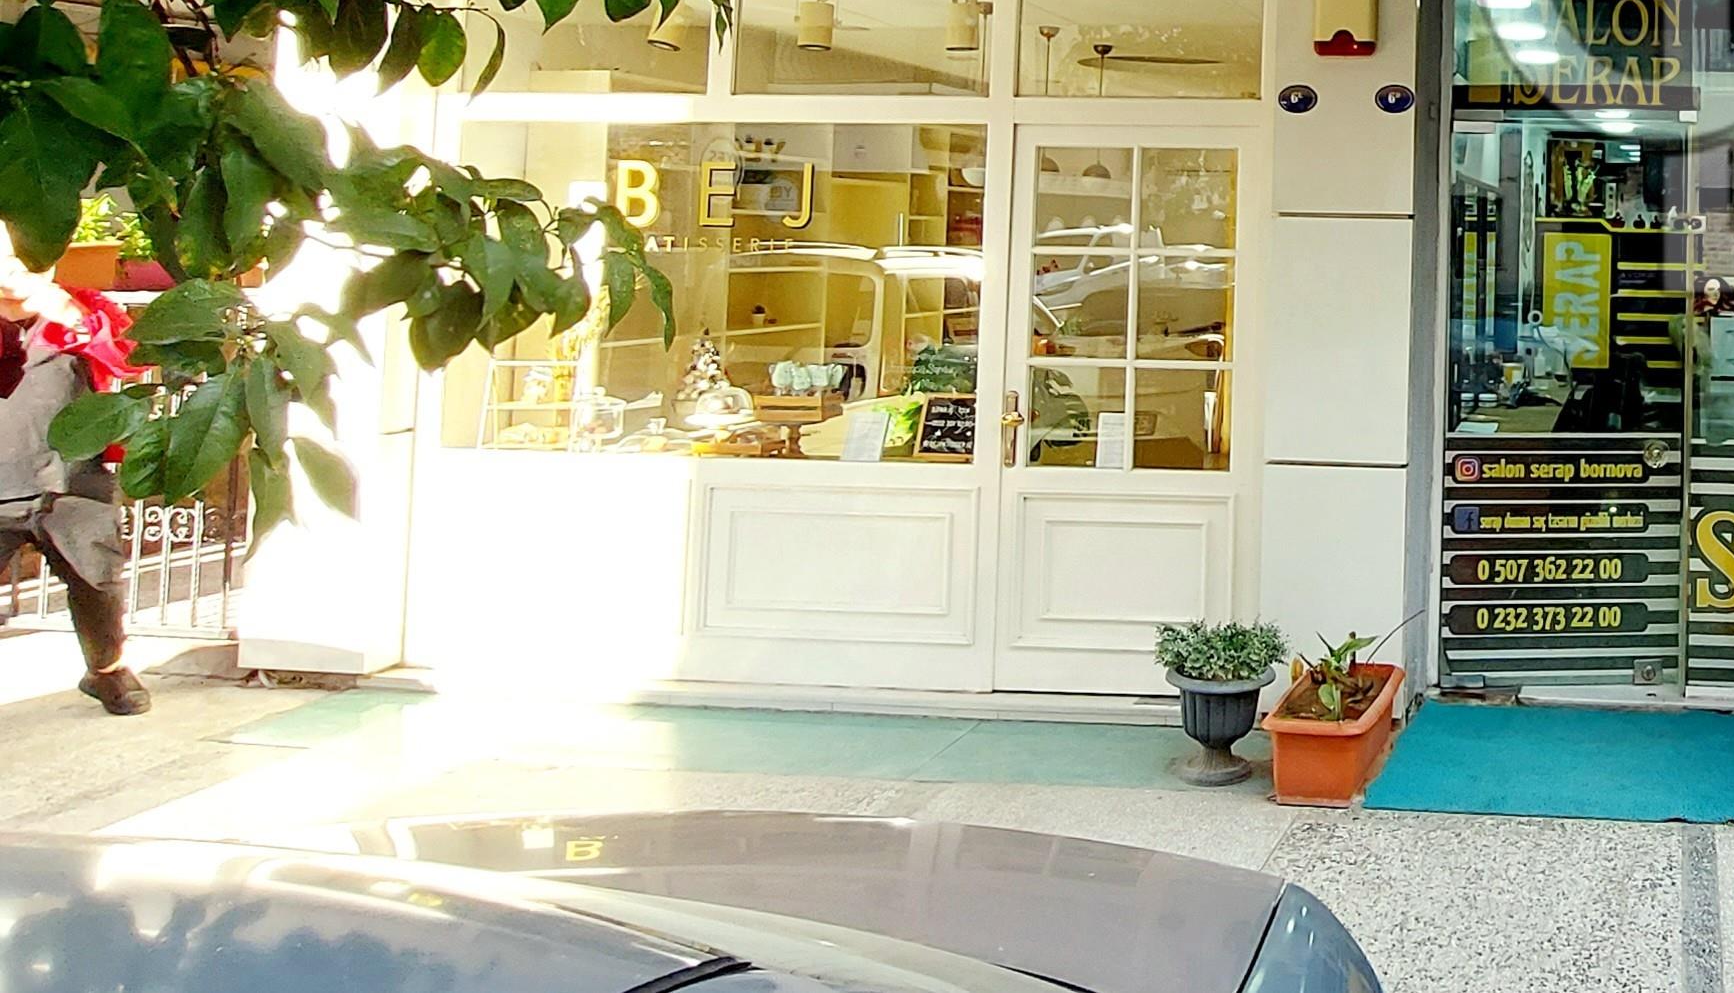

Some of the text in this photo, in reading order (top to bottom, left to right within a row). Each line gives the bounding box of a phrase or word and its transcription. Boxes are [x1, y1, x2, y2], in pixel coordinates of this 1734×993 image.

[1482, 458, 1643, 482] salon serap bornova
[1477, 557, 1622, 582] 0 507 362 22 00
[1476, 606, 1621, 631] 0 232 373 22 00
